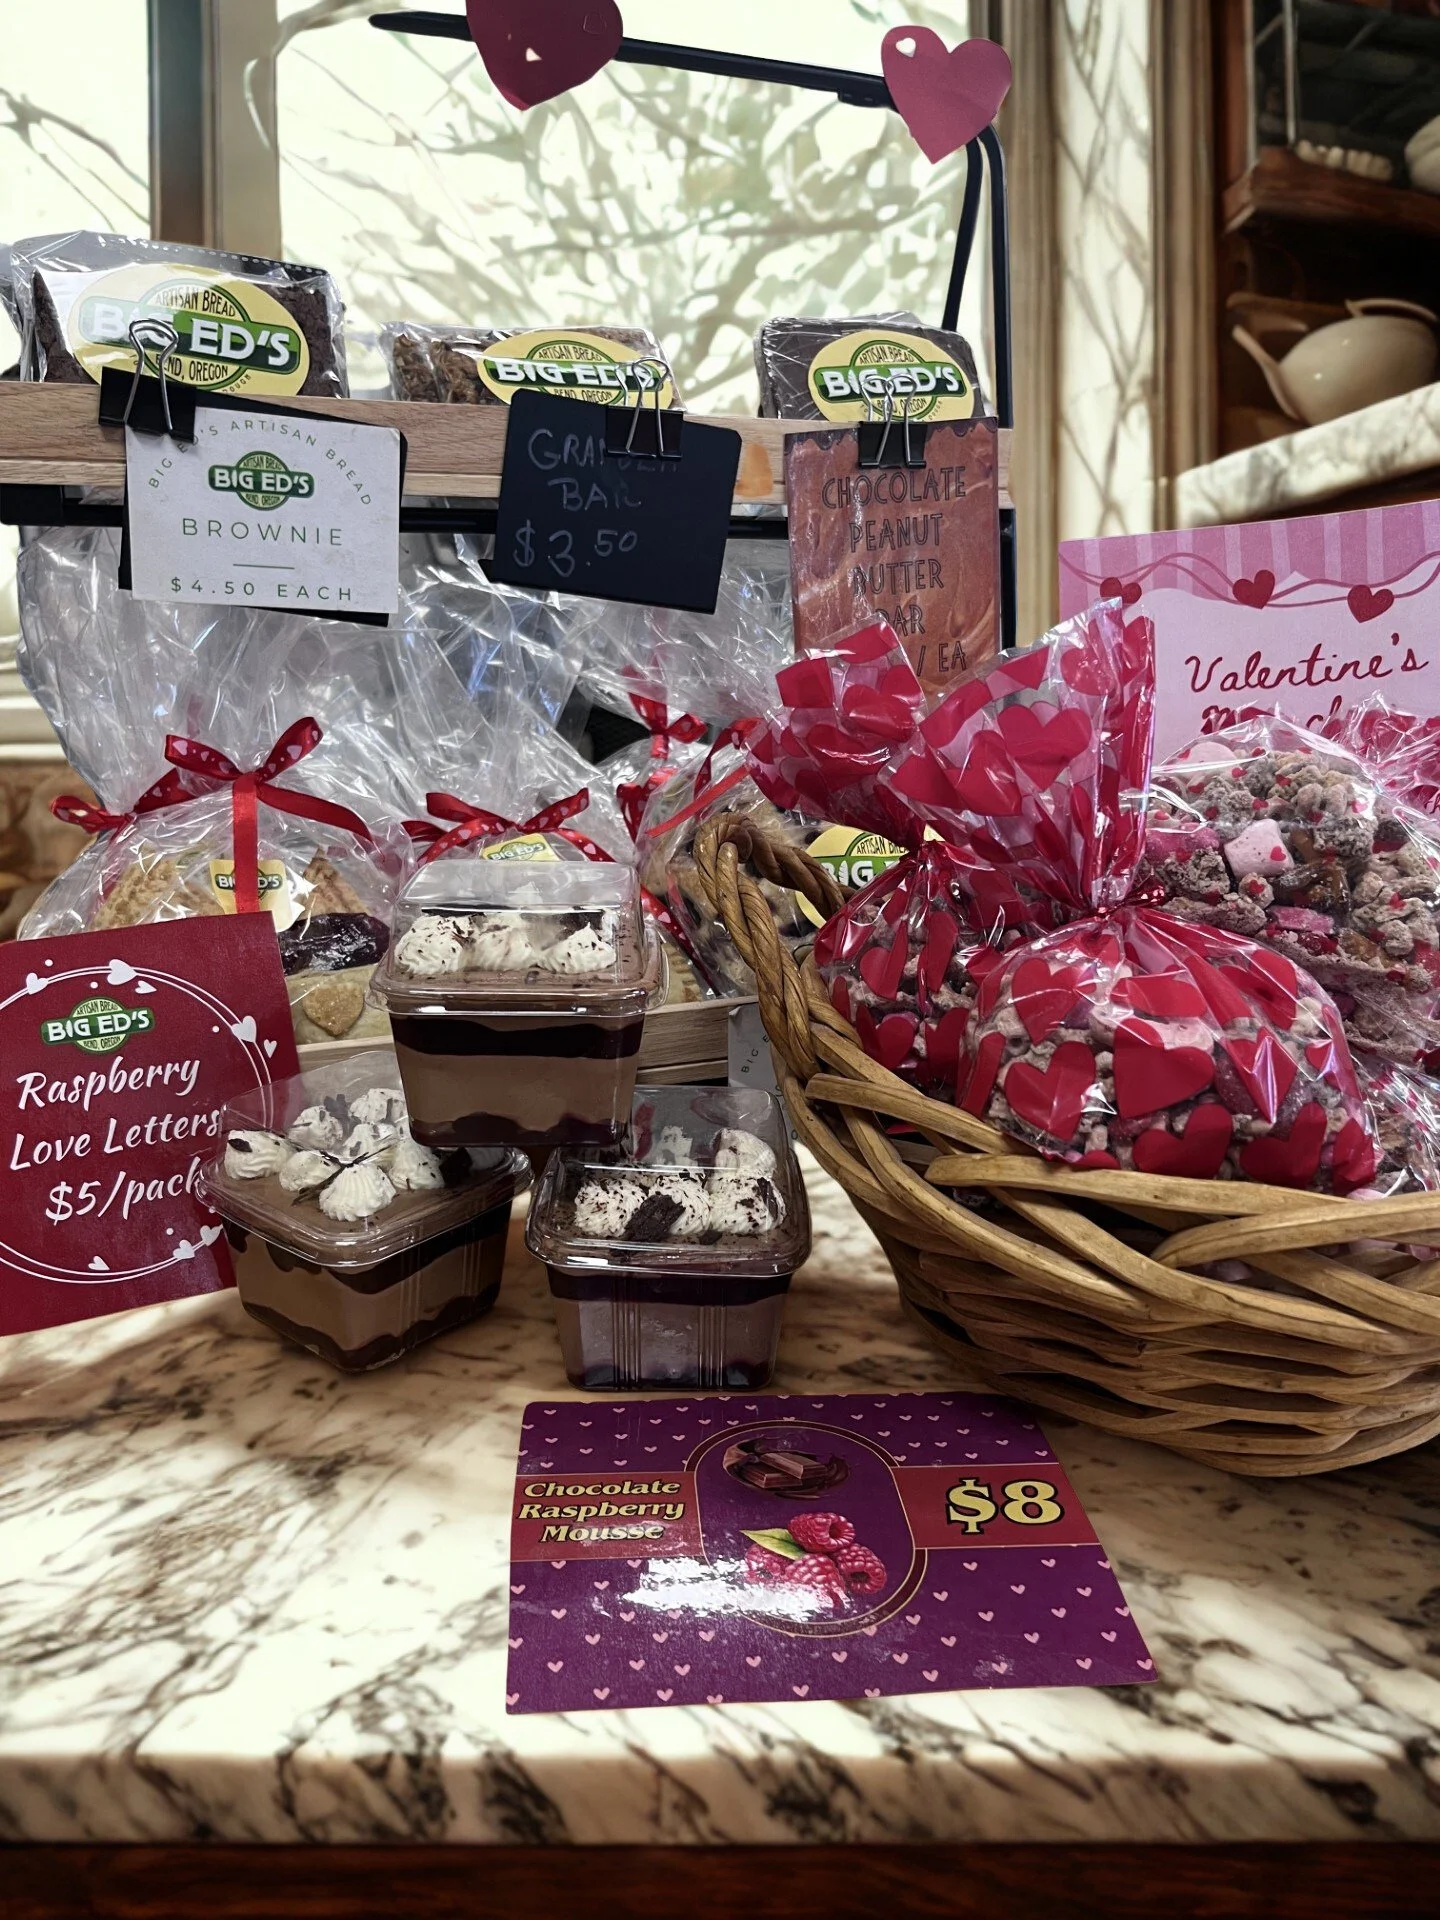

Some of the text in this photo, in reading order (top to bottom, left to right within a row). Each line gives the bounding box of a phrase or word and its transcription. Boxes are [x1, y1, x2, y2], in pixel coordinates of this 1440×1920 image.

[155, 289, 236, 318] ARTISAN BREAD
[189, 317, 290, 367] ED'S
[538, 345, 603, 362] ARTISAN BREAD
[859, 345, 915, 365] ARTISAN BREAD
[156, 353, 185, 381] ND,
[188, 360, 229, 382] OREGON
[496, 361, 566, 385] BIG
[822, 366, 960, 398] BIG ED'S
[148, 457, 173, 489] BIG
[230, 419, 317, 446] ARTISAN
[325, 448, 372, 506] BREAD
[243, 455, 265, 469] ARTISAN
[214, 467, 310, 494] BIG ED'S
[548, 476, 642, 512] BAR
[821, 466, 967, 510] CHOCOLATE
[182, 517, 342, 546] BROWNIE
[849, 513, 944, 553] PEANUT
[513, 519, 638, 577] $3.50
[170, 576, 352, 601] $4.50 EACH
[938, 641, 967, 673] EA
[1184, 632, 1430, 693] Valentine's
[856, 836, 887, 855] ARTISAN
[218, 875, 280, 888] BI D'S
[77, 1000, 118, 1015] ARTISAN BREAD
[47, 1009, 150, 1041] BIG ED'S
[16, 1055, 201, 1112] Raspberry
[9, 1111, 221, 1172] Love Letters
[45, 1157, 206, 1227] $5/pack
[523, 1480, 681, 1498] Chocolate
[518, 1502, 685, 1523] Raspberry
[947, 1477, 1064, 1536] $8
[540, 1525, 666, 1544] Mousse
